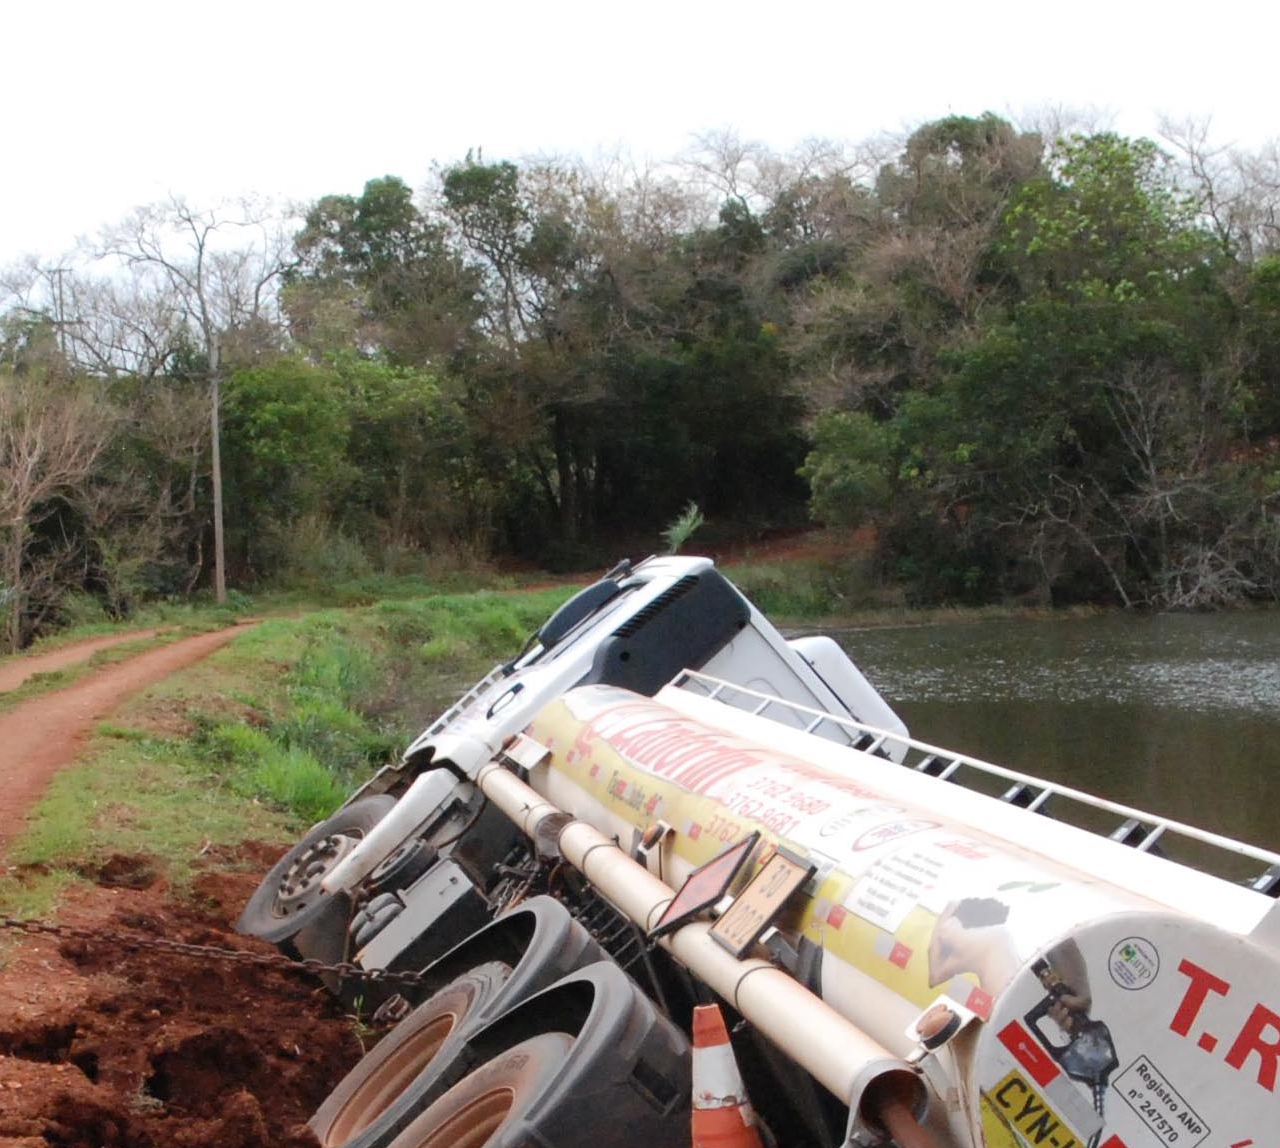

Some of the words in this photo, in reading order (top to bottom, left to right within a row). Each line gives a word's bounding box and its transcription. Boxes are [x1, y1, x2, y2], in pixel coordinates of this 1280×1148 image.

[728, 792, 764, 818] 3762
[759, 863, 792, 898] 30
[1135, 1063, 1178, 1112] Registro
[1177, 1111, 1202, 1135] ANP
[1140, 1100, 1179, 1143] 247570
